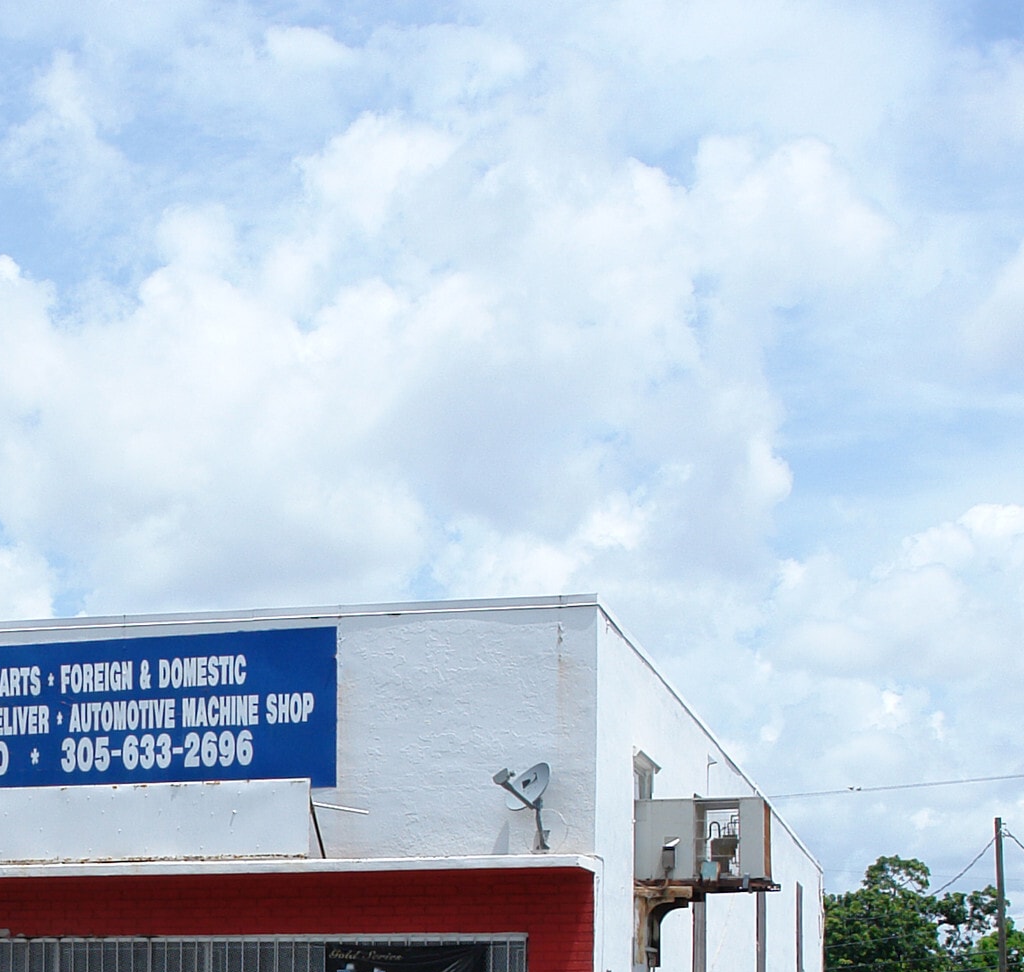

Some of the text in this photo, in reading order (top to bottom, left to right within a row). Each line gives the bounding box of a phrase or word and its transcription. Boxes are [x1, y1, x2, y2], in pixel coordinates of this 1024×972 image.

[60, 661, 133, 694] FOREIGN
[139, 659, 151, 690] &
[159, 655, 247, 689] DOMESTIC
[69, 698, 176, 733] AUTOMOTIVE
[182, 694, 259, 728] MACHINE
[266, 692, 315, 724] SHOP
[61, 730, 254, 773] 305-633-2696
